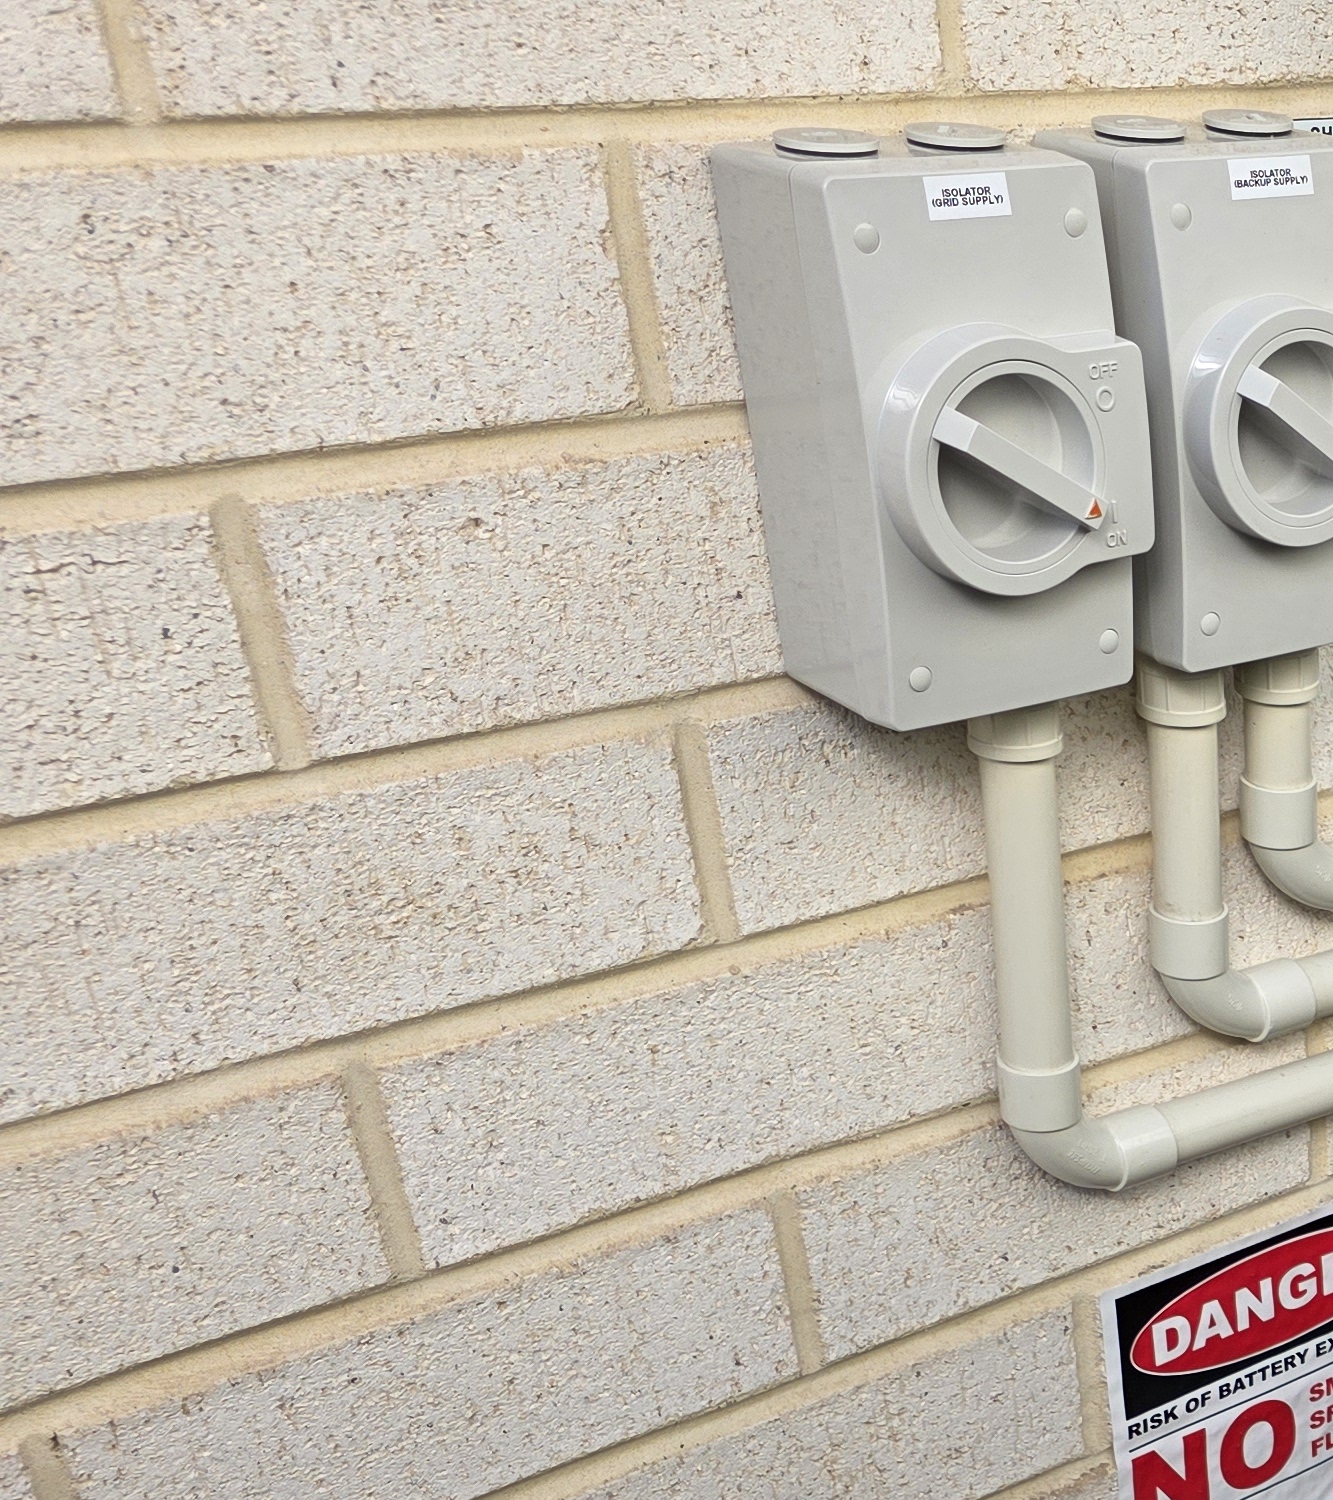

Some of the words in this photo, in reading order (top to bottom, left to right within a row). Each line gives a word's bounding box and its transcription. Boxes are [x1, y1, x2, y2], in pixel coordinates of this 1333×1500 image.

[1250, 168, 1291, 179] ISOLATOR
[1234, 178, 1271, 188] (BACKUP
[1274, 175, 1309, 186] SUPPLY)
[942, 186, 991, 197] ISOLATOR
[932, 198, 959, 208] (GRID
[962, 194, 1004, 206] SUPPLY)
[1088, 360, 1119, 380] OFF
[1106, 529, 1128, 548] ON
[1127, 1408, 1179, 1441] RISK
[1185, 1389, 1212, 1414] OF
[1218, 1346, 1309, 1402] BATTERY
